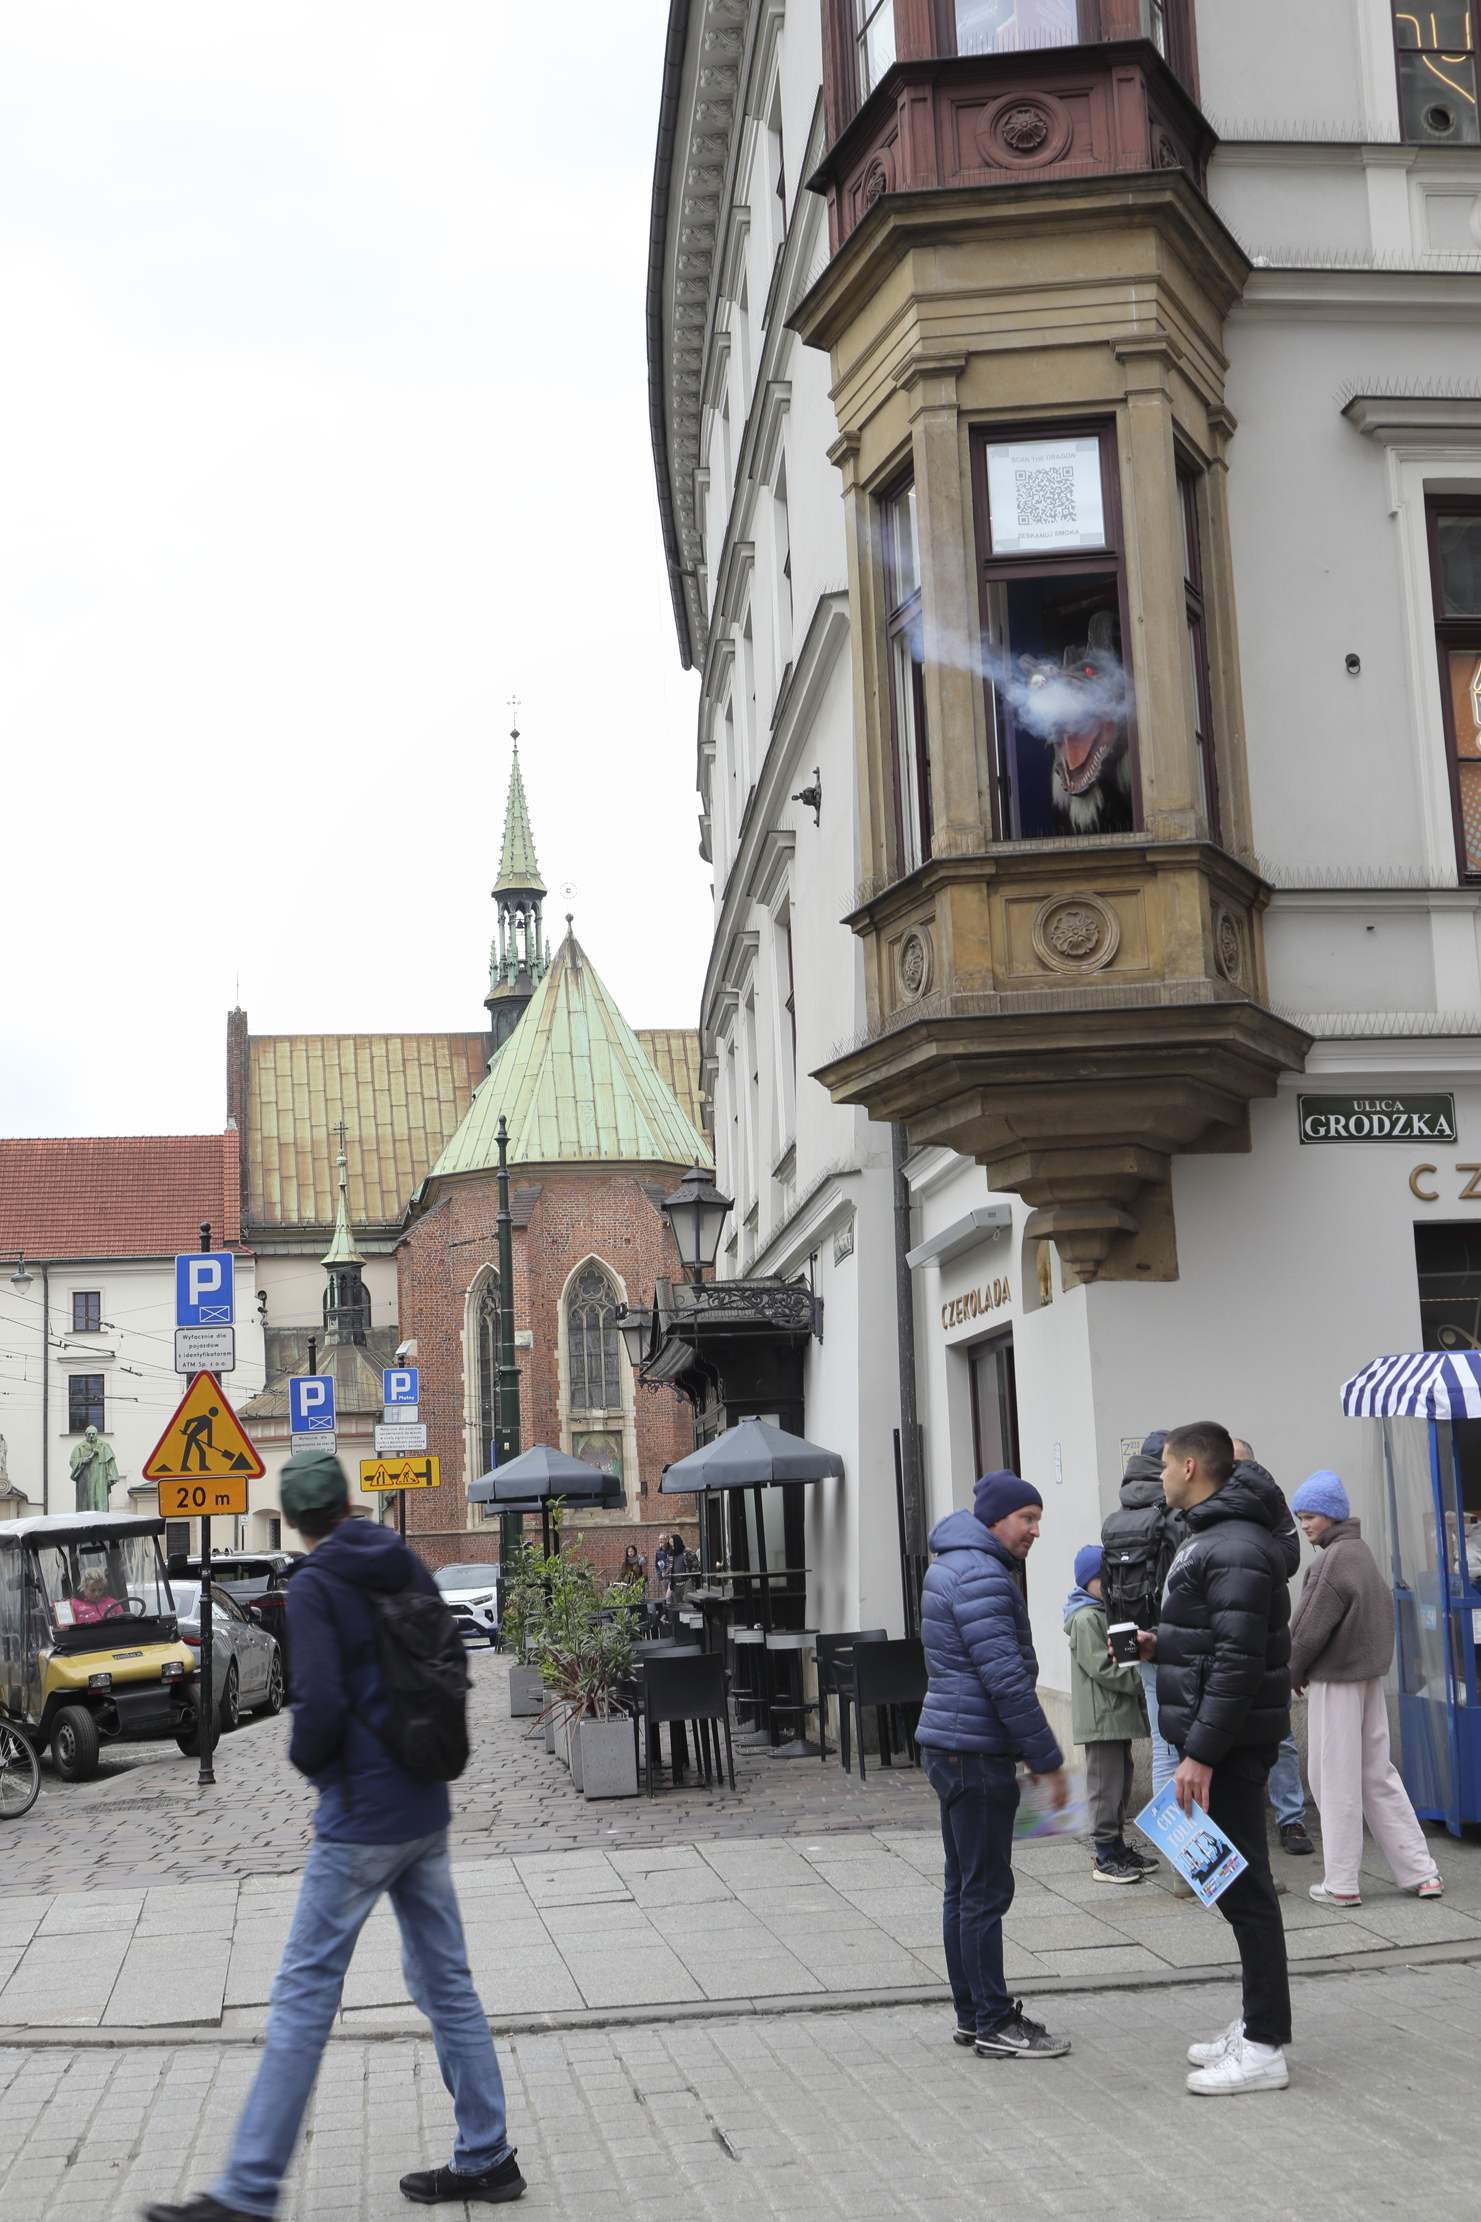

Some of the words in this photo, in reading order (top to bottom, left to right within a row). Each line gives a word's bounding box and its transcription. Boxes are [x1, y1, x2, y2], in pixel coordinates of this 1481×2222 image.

[1046, 452, 1076, 461] DRAGON
[1017, 531, 1053, 539] ZESKANUJ
[1353, 1100, 1405, 1111] ULICA
[1304, 1113, 1453, 1137] GRODZKA
[189, 1259, 222, 1305] P
[942, 1275, 1011, 1331] CZEKOLADA
[182, 1333, 214, 1341] Wyłącznie
[391, 1372, 411, 1400] P
[300, 1381, 325, 1417] P
[177, 1486, 206, 1508] 20
[215, 1494, 229, 1505] m
[1156, 1801, 1182, 1831] CITY
